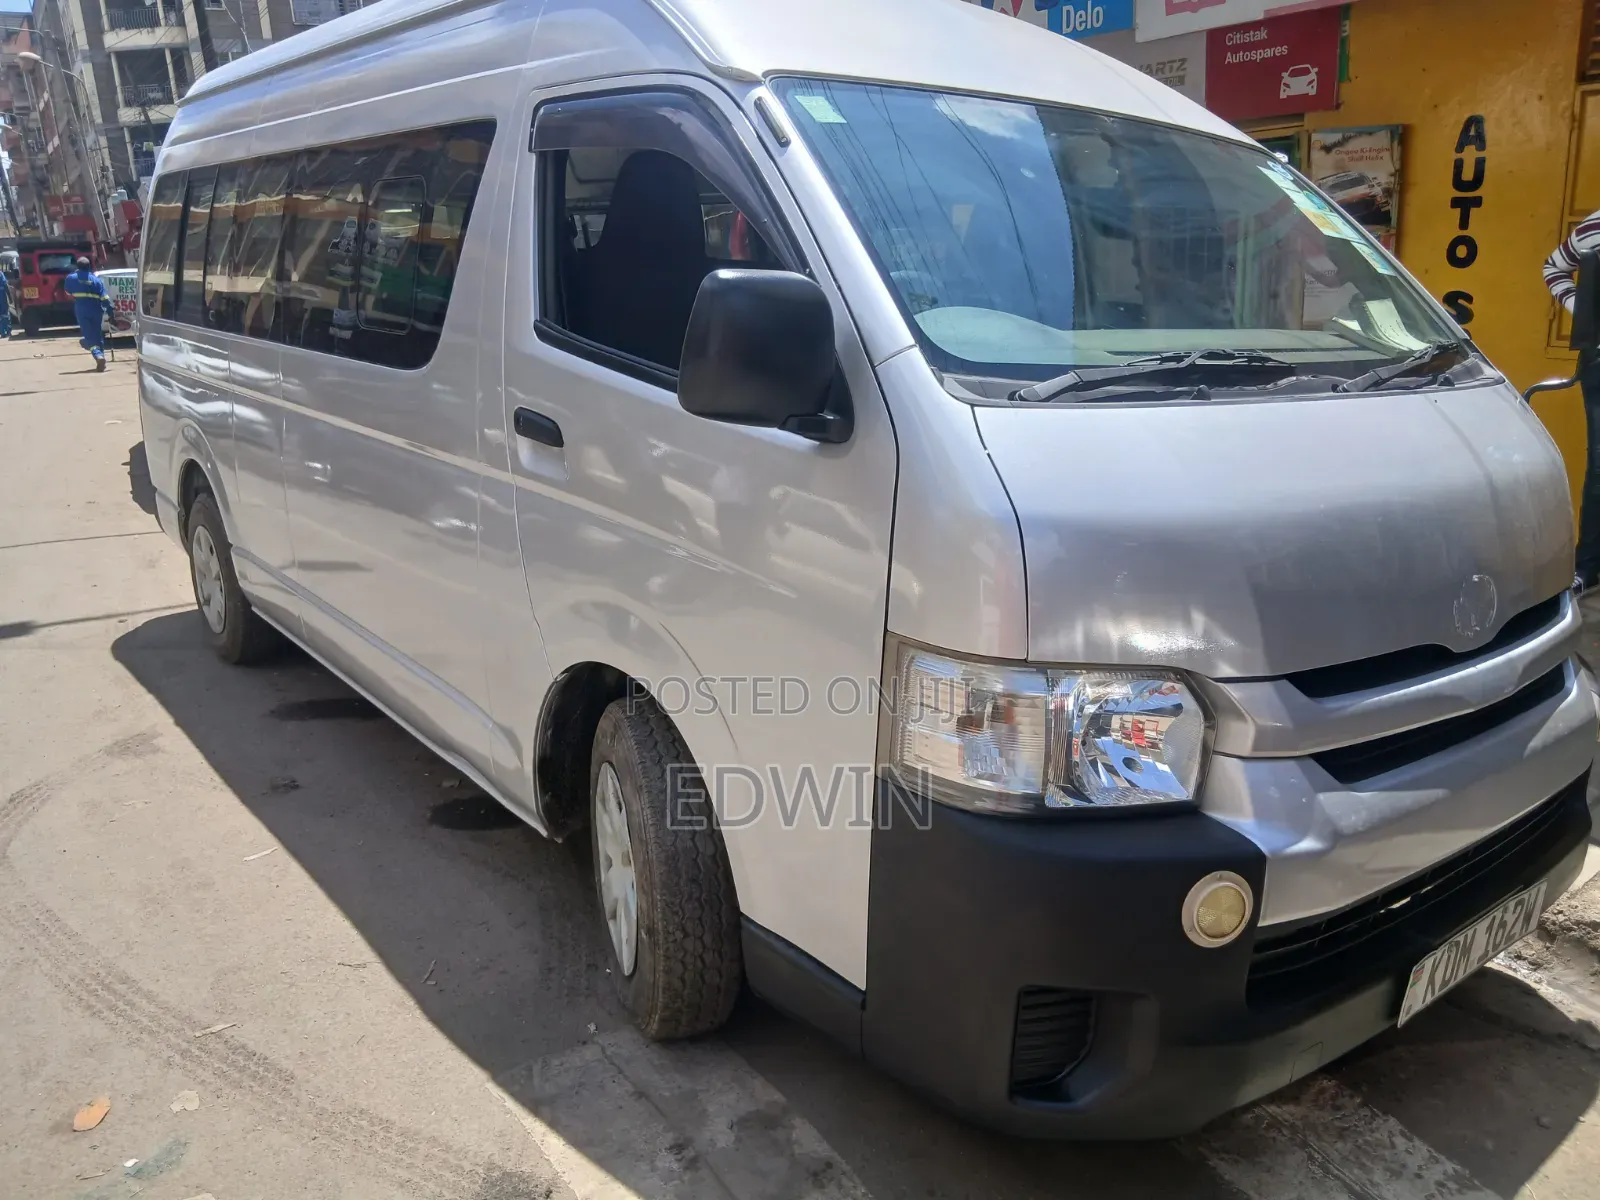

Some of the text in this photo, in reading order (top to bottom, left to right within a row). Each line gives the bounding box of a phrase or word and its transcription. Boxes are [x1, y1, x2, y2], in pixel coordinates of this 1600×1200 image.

[1062, 1, 1104, 34] Delo
[1225, 27, 1268, 46] Citistak
[1224, 45, 1289, 65] Autospares
[1134, 57, 1188, 78] ARTZ
[1446, 114, 1487, 269] AUTO
[108, 277, 136, 286] MAM
[118, 286, 136, 294] RES
[1422, 887, 1541, 1004] KDM 162W
